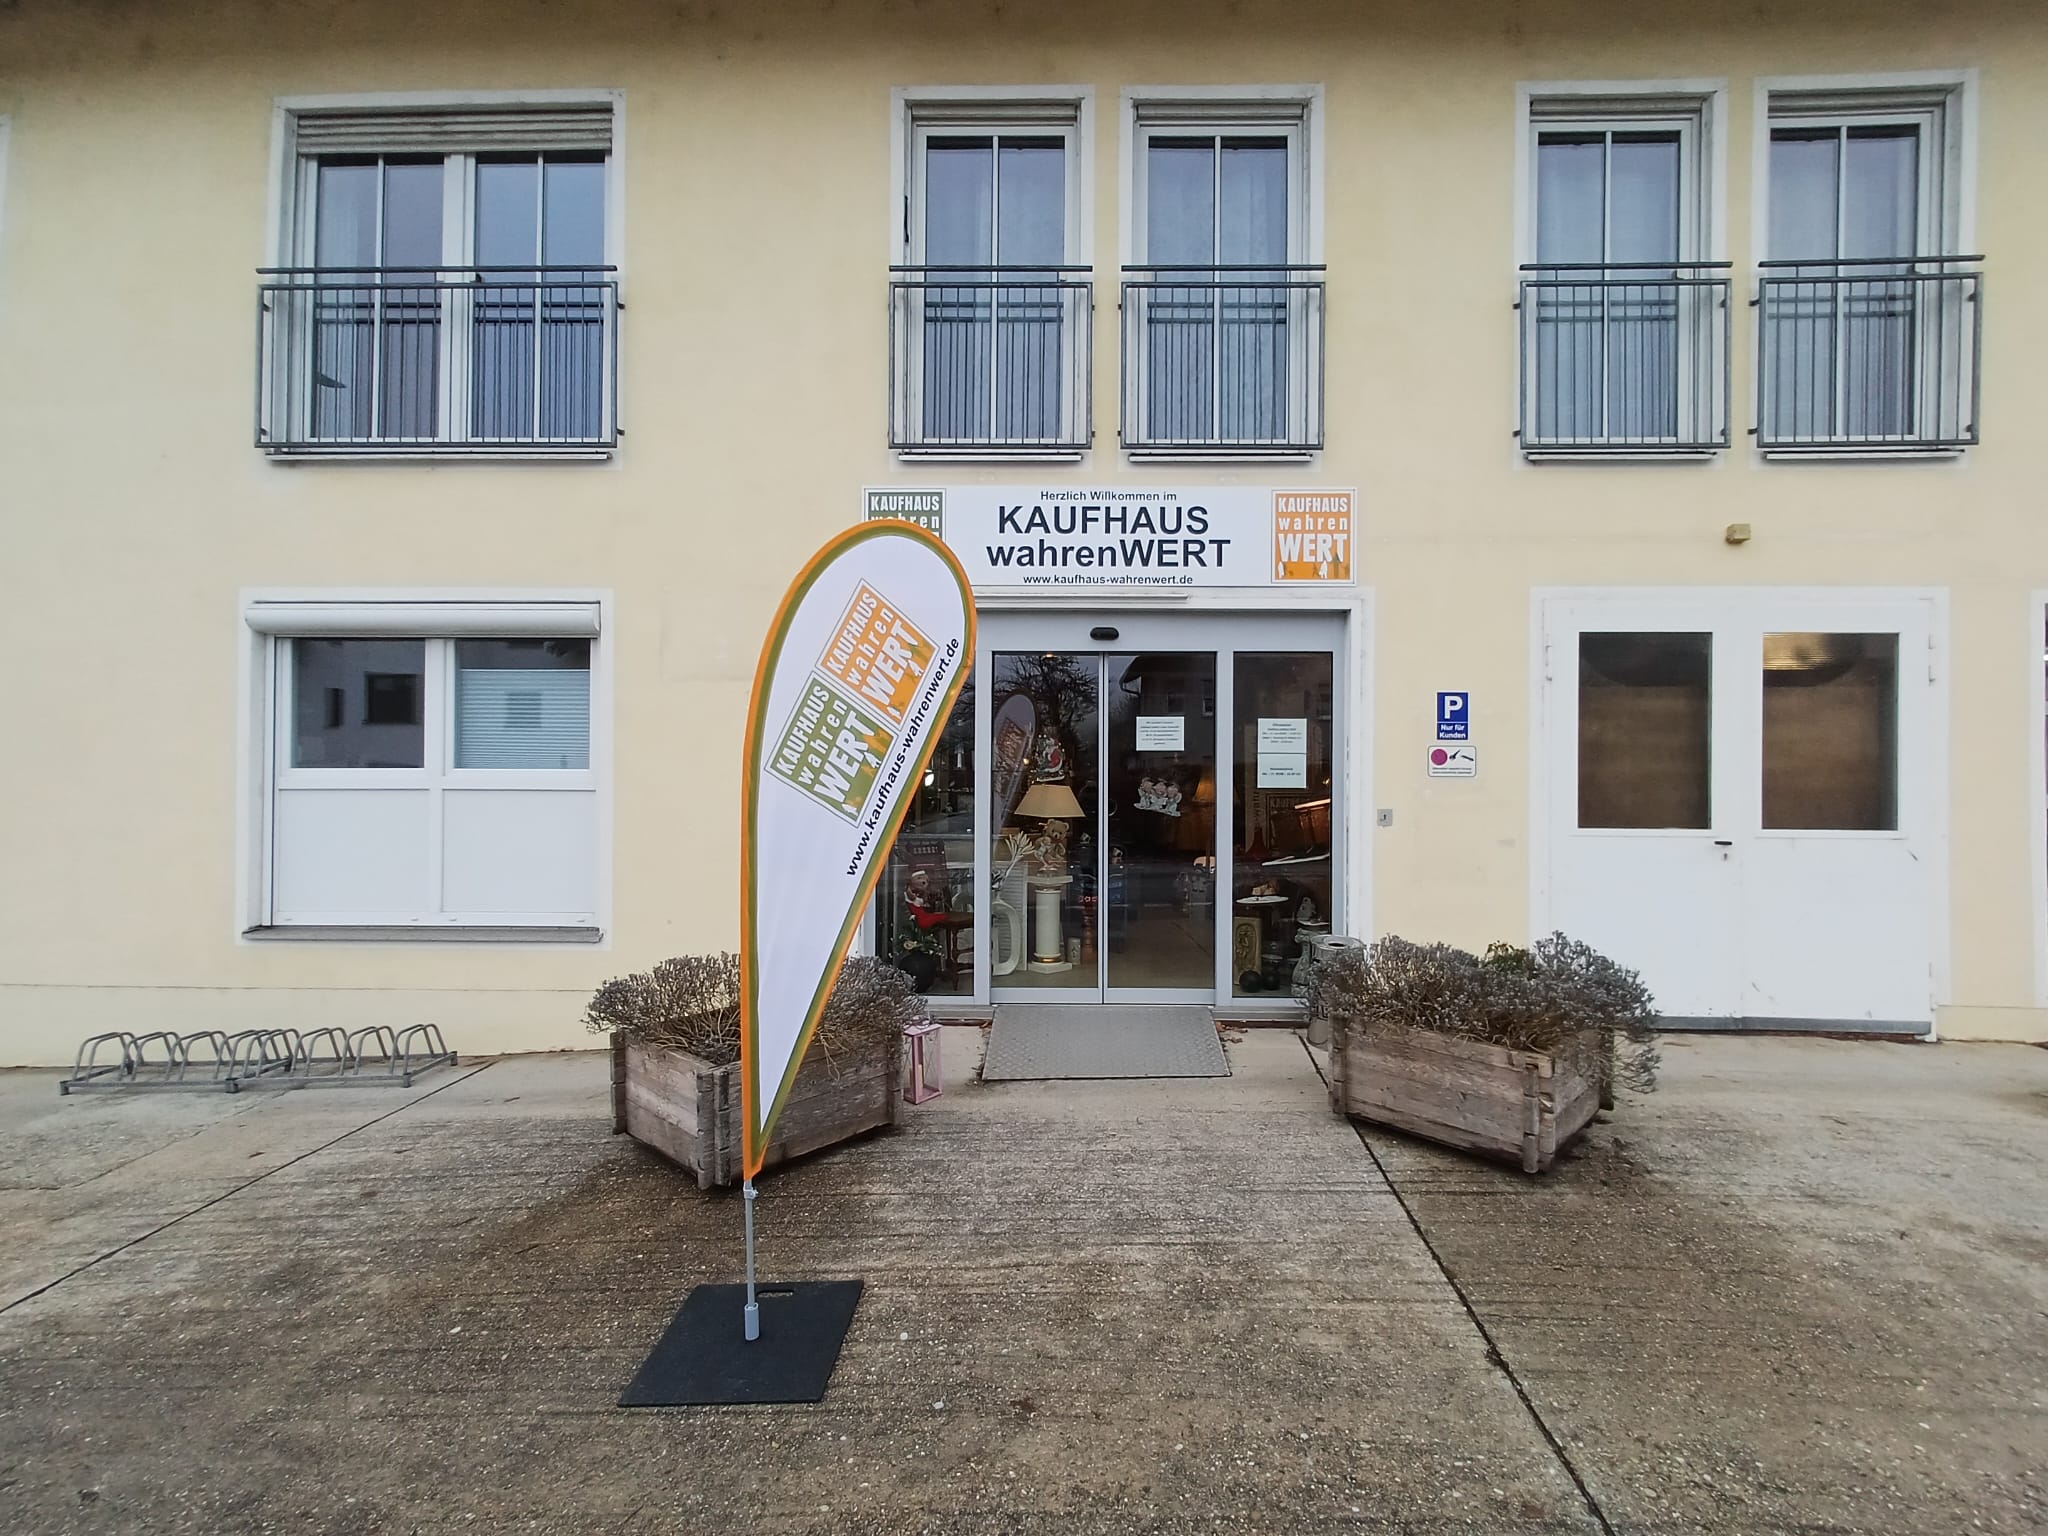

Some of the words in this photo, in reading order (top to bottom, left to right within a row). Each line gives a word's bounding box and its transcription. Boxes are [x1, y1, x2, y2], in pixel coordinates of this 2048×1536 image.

[870, 495, 940, 512] KAUFHAUS
[1040, 490, 1087, 502] Herzlich
[1090, 491, 1160, 502] Willkommen
[1163, 491, 1178, 501] im
[1278, 497, 1348, 513] KAUFHAUS
[998, 505, 1209, 534] KAUFHAUS
[1278, 513, 1348, 531] wahren
[985, 538, 1231, 568] wahrenWERT
[1278, 533, 1348, 562] WERT
[1022, 574, 1194, 585] www.kaufhaus-wahrenwert.de
[826, 592, 878, 674] KAUFHAUS
[846, 607, 894, 686] wahren
[860, 619, 919, 706] WERT
[1444, 695, 1463, 719] P
[776, 686, 830, 776] KAUFHAUS
[798, 699, 848, 786] wahren
[814, 711, 875, 804] WERT
[846, 637, 960, 876] www.kaufhaus-wahrenwert.de
